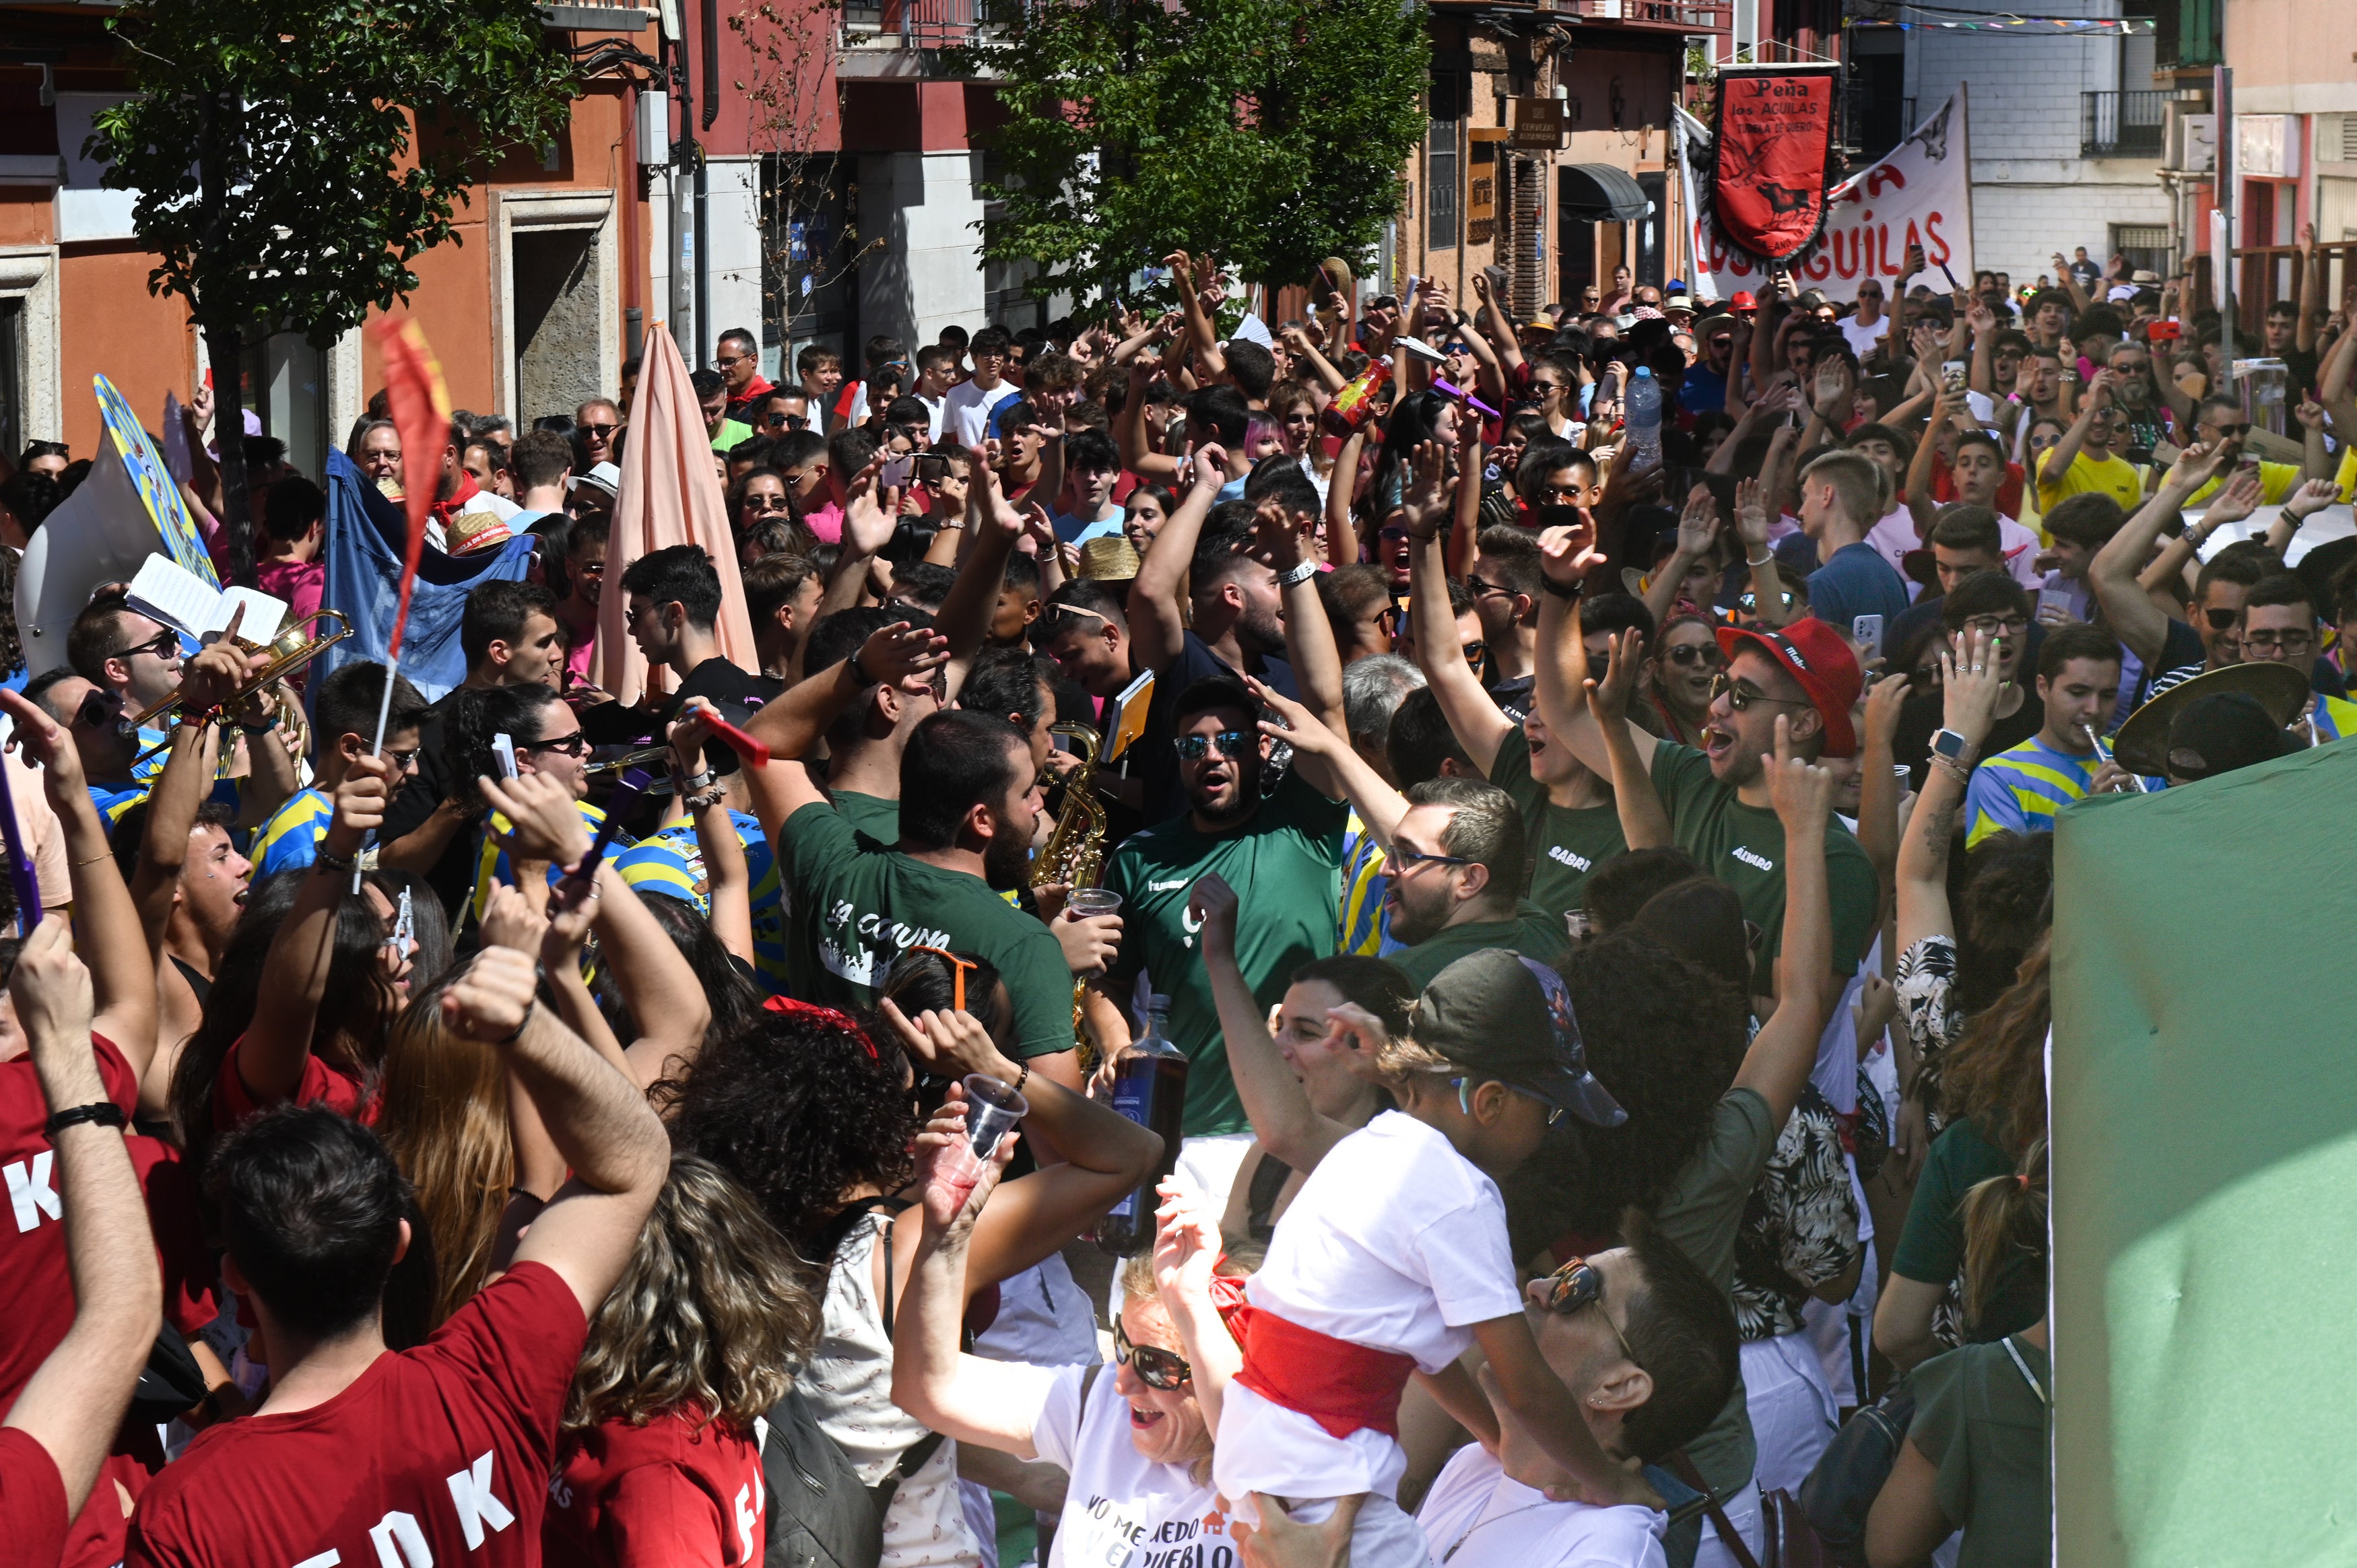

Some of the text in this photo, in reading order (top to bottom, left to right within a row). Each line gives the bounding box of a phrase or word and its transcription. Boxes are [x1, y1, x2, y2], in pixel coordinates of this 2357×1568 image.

[1746, 79, 1809, 97] Peña
[1732, 103, 1754, 116] los
[1521, 123, 1556, 132] CERVEZAS
[1774, 123, 1785, 133] DE
[1787, 122, 1812, 133] DUERO
[1548, 846, 1591, 873] SABRI
[1732, 846, 1772, 871] ÁLVARO
[1114, 1515, 1147, 1546] ME
